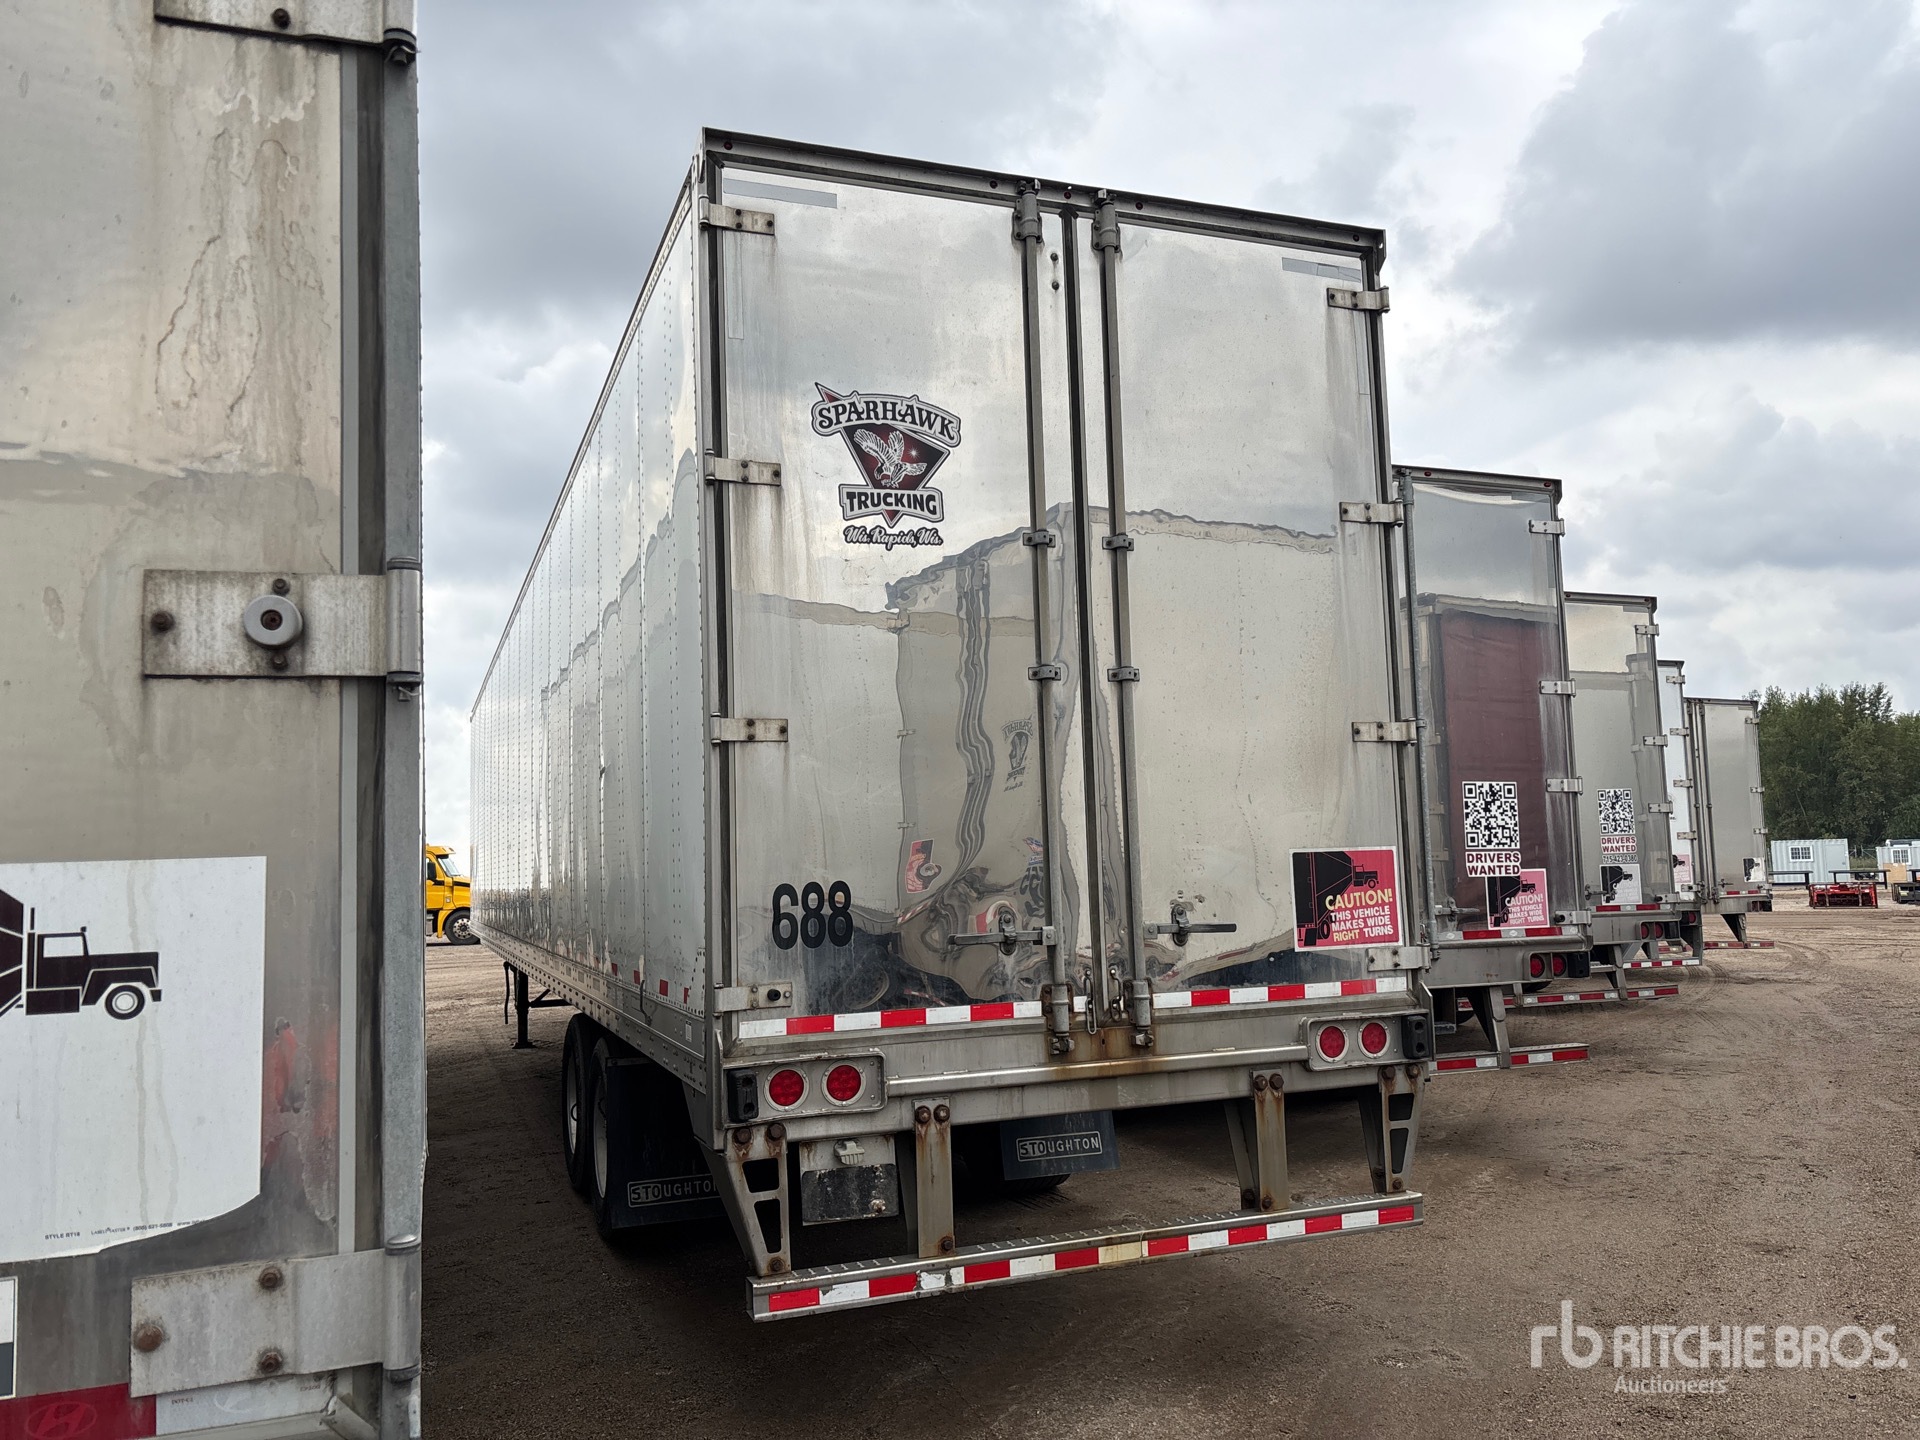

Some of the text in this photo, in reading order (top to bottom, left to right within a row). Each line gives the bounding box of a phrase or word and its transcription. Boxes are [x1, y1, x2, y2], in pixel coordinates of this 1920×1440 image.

[818, 400, 956, 441] SPARHAWK
[846, 491, 937, 515] TRUCKING
[844, 525, 943, 551] Wis. Rapids, Wis.
[1467, 852, 1520, 863] DRIVERS
[1602, 845, 1636, 853] WANTED
[1468, 864, 1520, 875] WANTED
[1325, 888, 1393, 911] CAUTION!
[1505, 894, 1544, 906] CAUTION!
[772, 880, 853, 950] 688
[1330, 905, 1390, 922] THIS VEHICLE
[1331, 915, 1391, 932] MAKES WIDE
[1333, 929, 1360, 942] RIGHT
[1363, 925, 1394, 938] TURNS
[1019, 1136, 1100, 1157] STOUGHTON
[44, 1232, 64, 1240] STYLE
